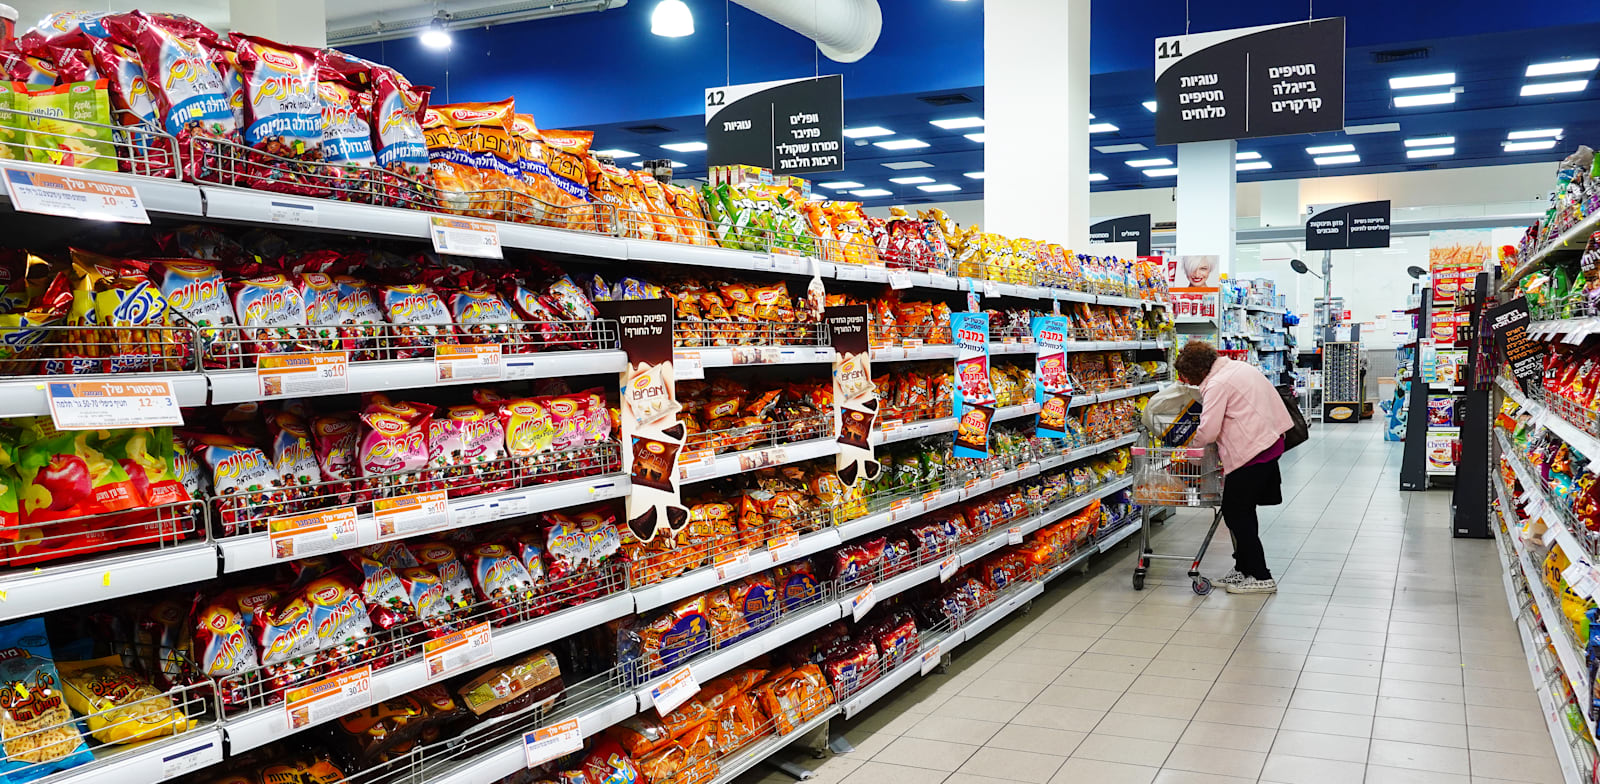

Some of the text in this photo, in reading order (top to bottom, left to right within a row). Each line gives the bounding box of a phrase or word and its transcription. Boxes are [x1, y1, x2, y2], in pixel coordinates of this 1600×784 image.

[1158, 41, 1182, 59] 11
[1268, 63, 1316, 78] חטיפים
[1180, 74, 1218, 88] עוגיות
[1272, 80, 1316, 96] בייגלה
[708, 90, 725, 106] 12
[1179, 90, 1224, 104] חטיפים
[1271, 97, 1322, 114] קרקרים
[790, 112, 819, 125] וופלים
[1182, 106, 1226, 121] מלוחים
[253, 116, 314, 140] גדולה במיוחד
[723, 120, 752, 132] עוגיות
[790, 128, 820, 139] פתיבר
[776, 140, 838, 156] ממרח שוקולד
[780, 156, 838, 169] ריבות חלבות
[61, 178, 86, 190] שלך
[102, 196, 138, 208] 3 10
[1308, 206, 1314, 214] 3
[391, 292, 440, 320] דובונים
[620, 315, 642, 324] החדש
[644, 314, 666, 326] הפינוק
[624, 325, 662, 338] של החורף!
[852, 324, 861, 332] של
[958, 329, 984, 344] במבה
[1040, 330, 1063, 342] במבה
[490, 354, 498, 364] 10
[333, 364, 344, 377] 10
[102, 384, 123, 396] שלך
[126, 385, 166, 395] הויקטורי
[139, 398, 172, 407] 3 12
[965, 416, 984, 431] במבה
[366, 432, 424, 462] דובונים
[434, 502, 445, 513] 10
[343, 520, 354, 532] 10
[802, 577, 814, 590] 3
[689, 616, 700, 634] 3
[480, 632, 488, 644] 10
[357, 679, 368, 692] 10
[8, 706, 32, 722] Ten
[672, 701, 703, 724] 25 5
[723, 732, 737, 745] 25
[741, 724, 749, 734] 5
[684, 767, 698, 783] 25
